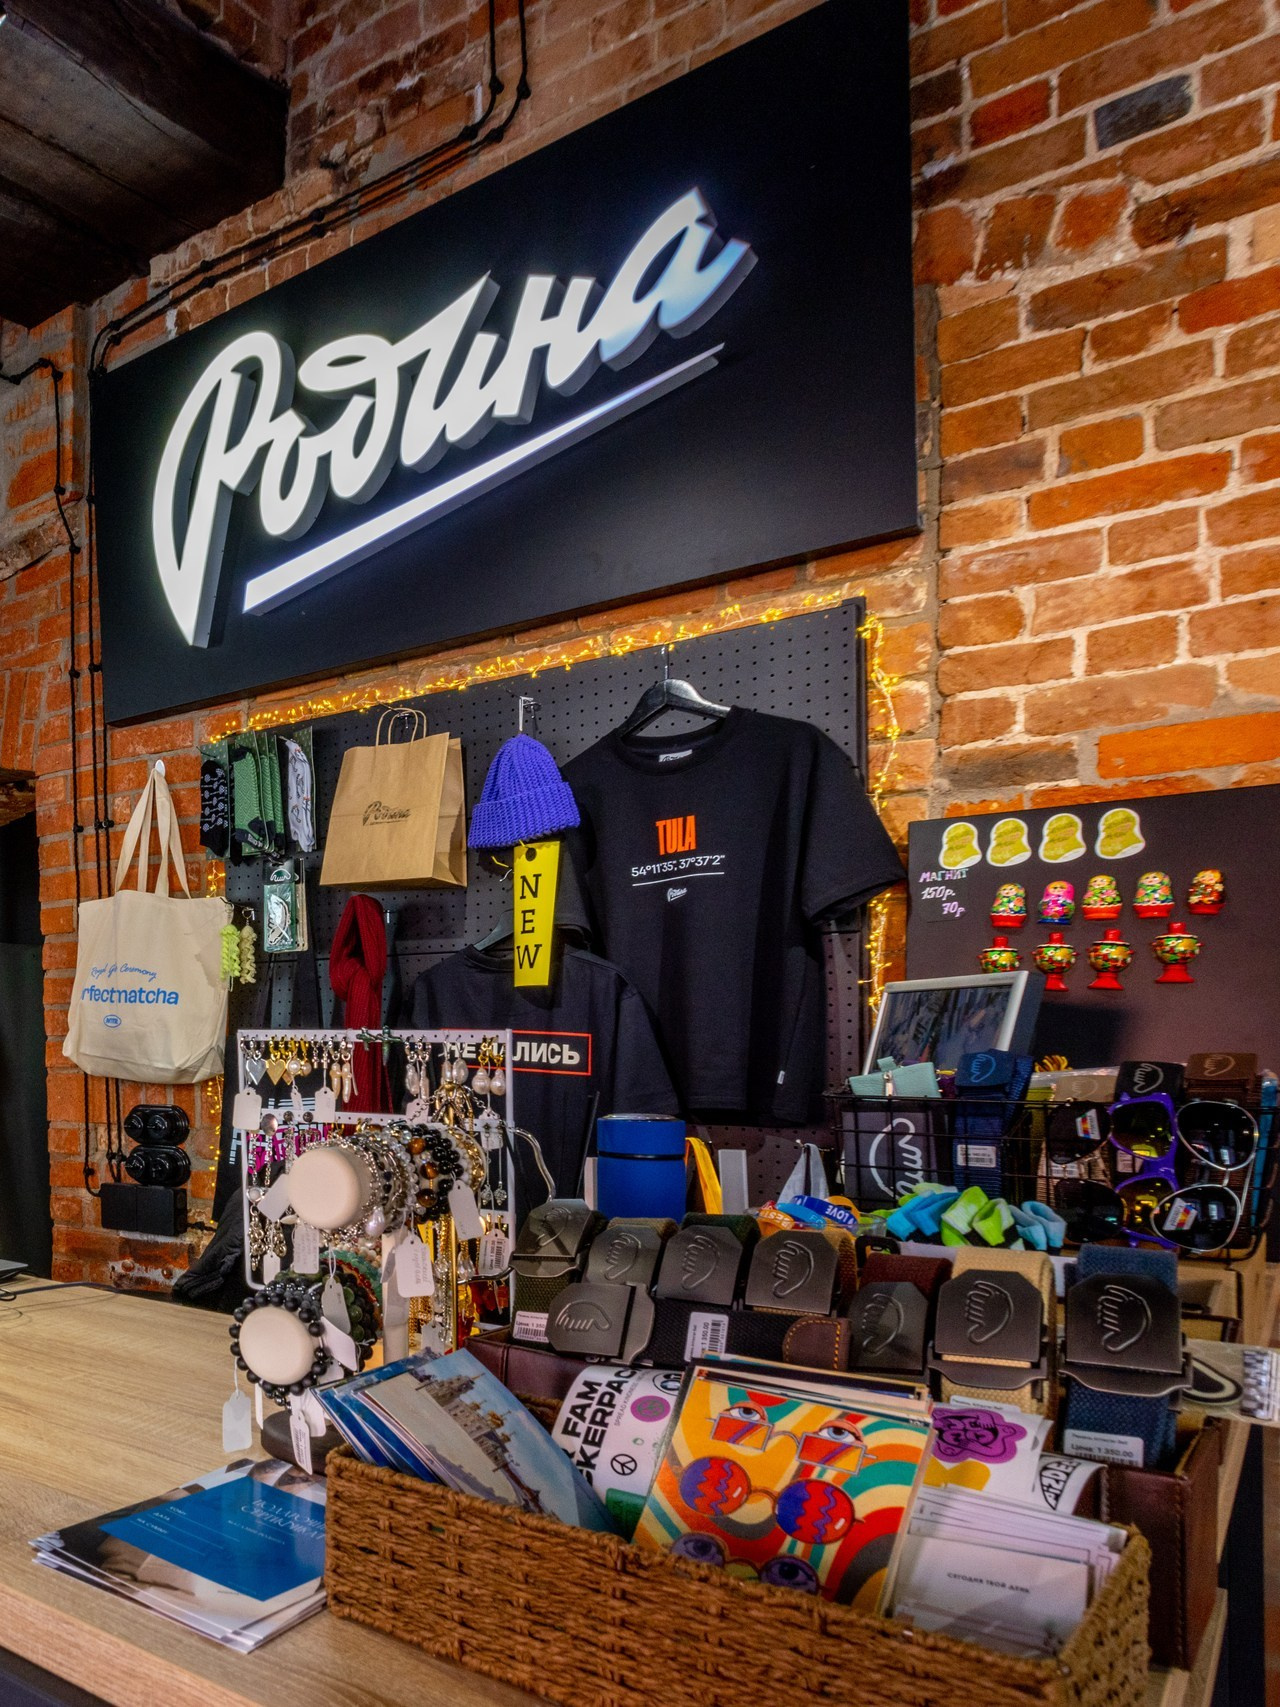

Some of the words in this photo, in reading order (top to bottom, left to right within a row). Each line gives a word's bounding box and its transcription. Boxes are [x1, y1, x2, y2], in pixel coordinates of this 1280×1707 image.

[152, 186, 758, 648] Родина
[655, 815, 697, 856] TULA
[918, 868, 969, 882] МАГНИТ
[516, 873, 543, 970] NEW
[81, 985, 179, 1005] rfectmatcha
[825, 1205, 850, 1224] LOVE
[561, 1380, 603, 1438] FAM
[576, 1368, 641, 1487] KERPAC
